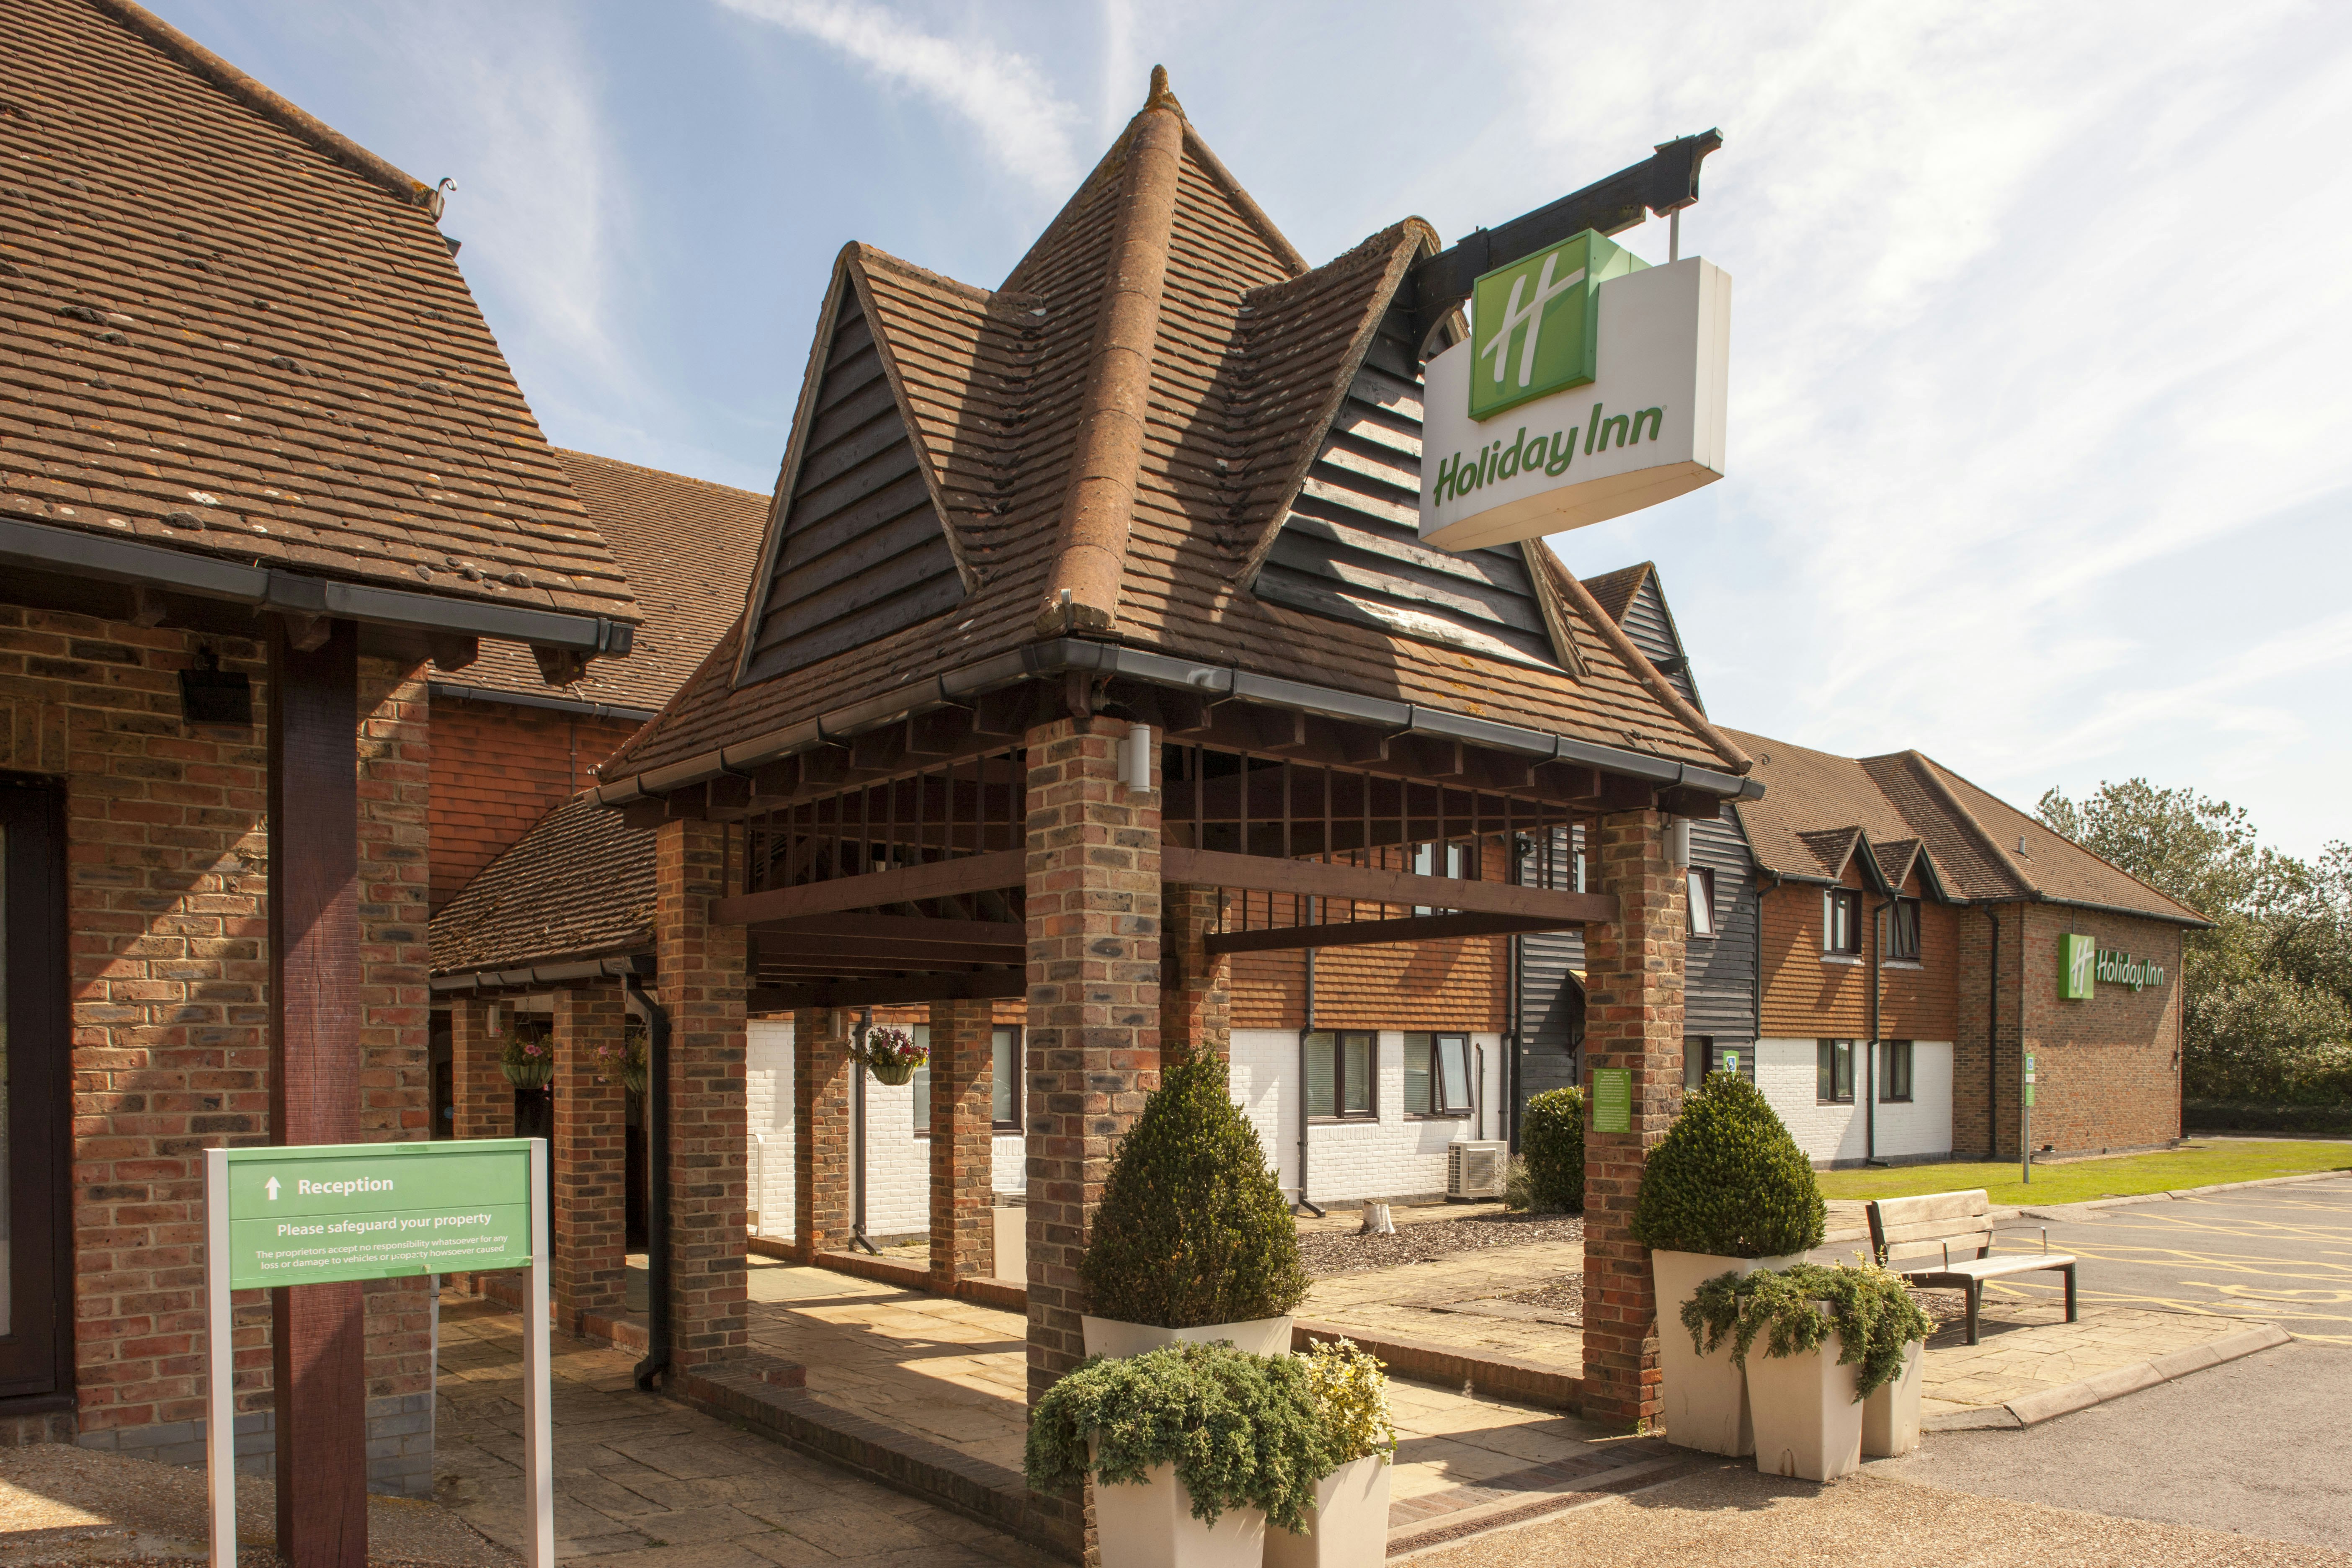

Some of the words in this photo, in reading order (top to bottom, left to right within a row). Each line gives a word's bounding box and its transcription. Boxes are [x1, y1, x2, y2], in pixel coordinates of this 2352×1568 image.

[1433, 427, 1579, 507] Holiday
[2096, 949, 2145, 992] Holiday
[2146, 959, 2164, 985] Inn
[298, 1176, 394, 1197] Reception
[277, 1223, 324, 1236] Please
[328, 1217, 397, 1234] safeguard
[400, 1218, 431, 1231] your
[433, 1213, 492, 1229] property
[256, 1251, 273, 1259] The
[275, 1248, 326, 1259] proprietors
[328, 1245, 358, 1254] accept
[373, 1239, 430, 1252] responsibility
[431, 1238, 479, 1246] whatsoever
[493, 1235, 508, 1243] any
[261, 1261, 279, 1270] loss
[293, 1259, 330, 1267] damage
[343, 1253, 378, 1263] vehicles
[391, 1250, 428, 1261] property
[430, 1249, 475, 1257] howsoever
[476, 1244, 505, 1254] caused
